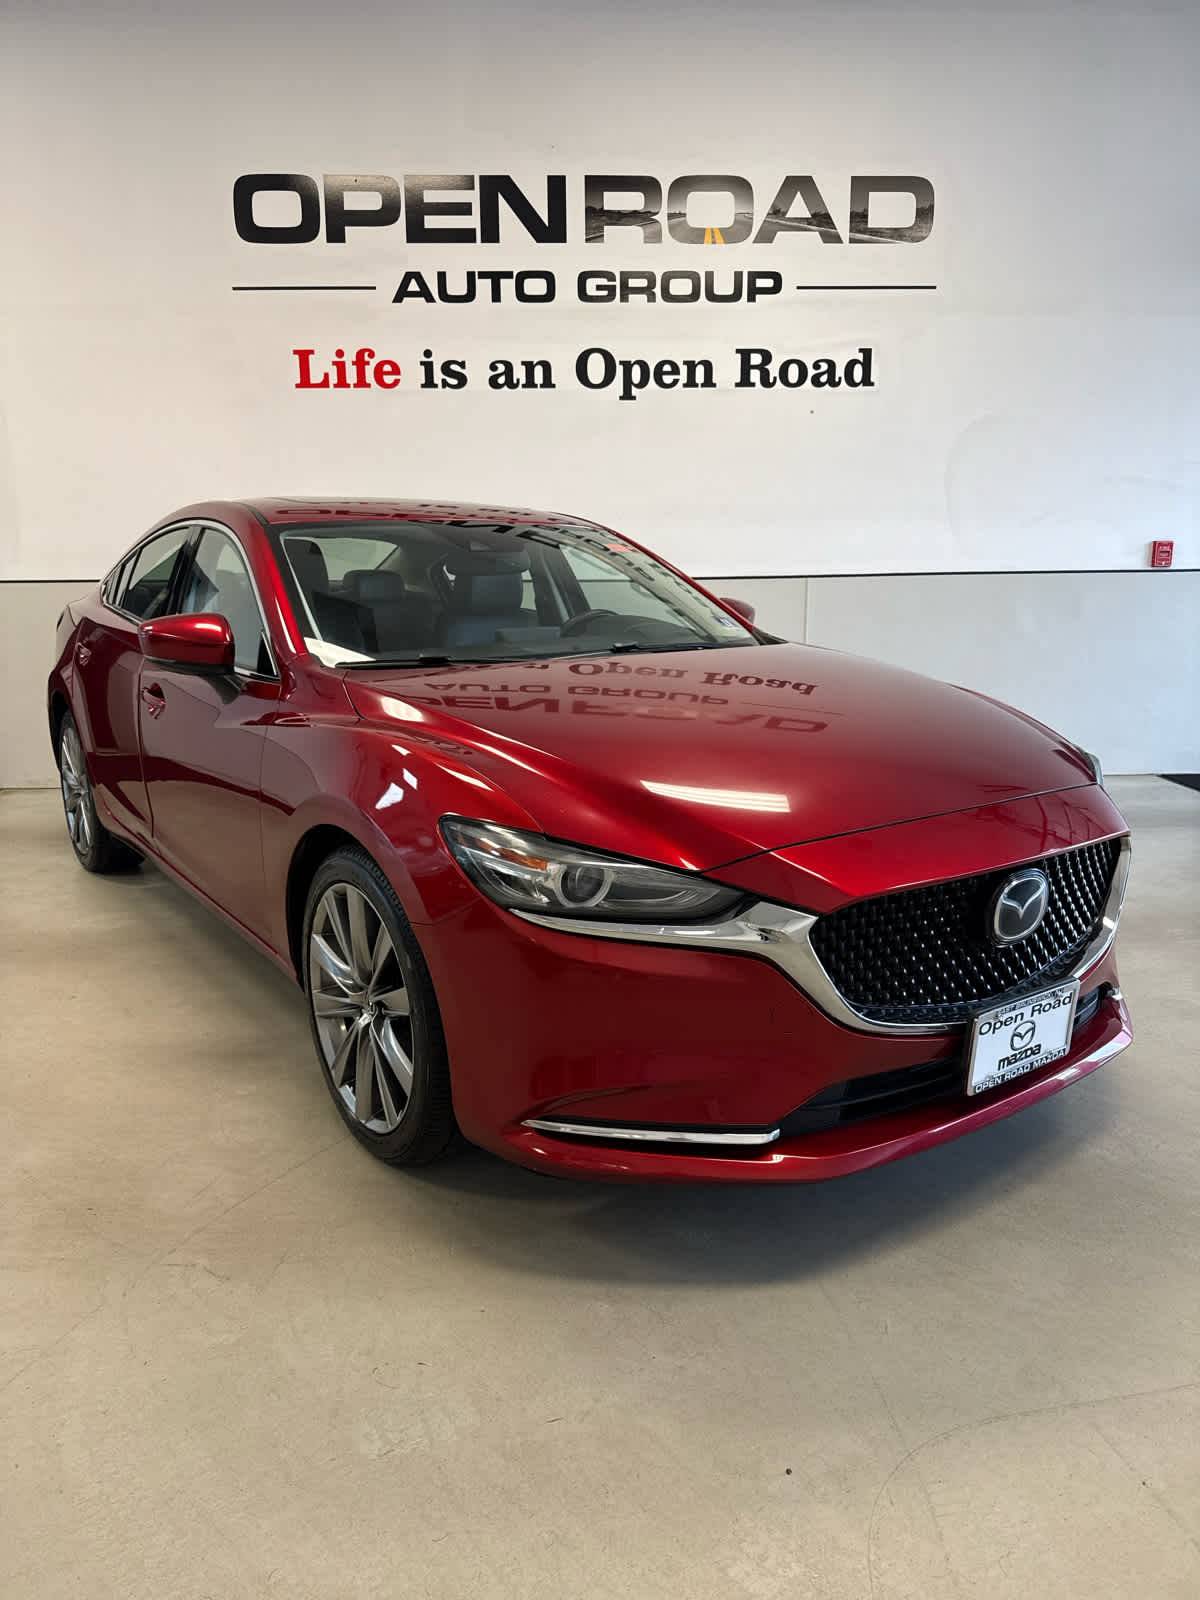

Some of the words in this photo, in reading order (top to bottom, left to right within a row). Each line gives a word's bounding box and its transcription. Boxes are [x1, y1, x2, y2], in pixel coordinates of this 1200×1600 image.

[233, 174, 567, 244] OPEN
[584, 174, 936, 245] ROAD
[392, 270, 556, 304] AUTO
[577, 270, 783, 304] GROUP
[293, 348, 401, 390] Life
[420, 348, 468, 390] is
[488, 359, 557, 390] an
[575, 347, 717, 401] Open
[734, 347, 875, 390] Road
[979, 1012, 1024, 1036] Open
[1030, 992, 1074, 1018] Road
[974, 1074, 1001, 1094] OPEN
[1004, 1062, 1031, 1081] ROAD
